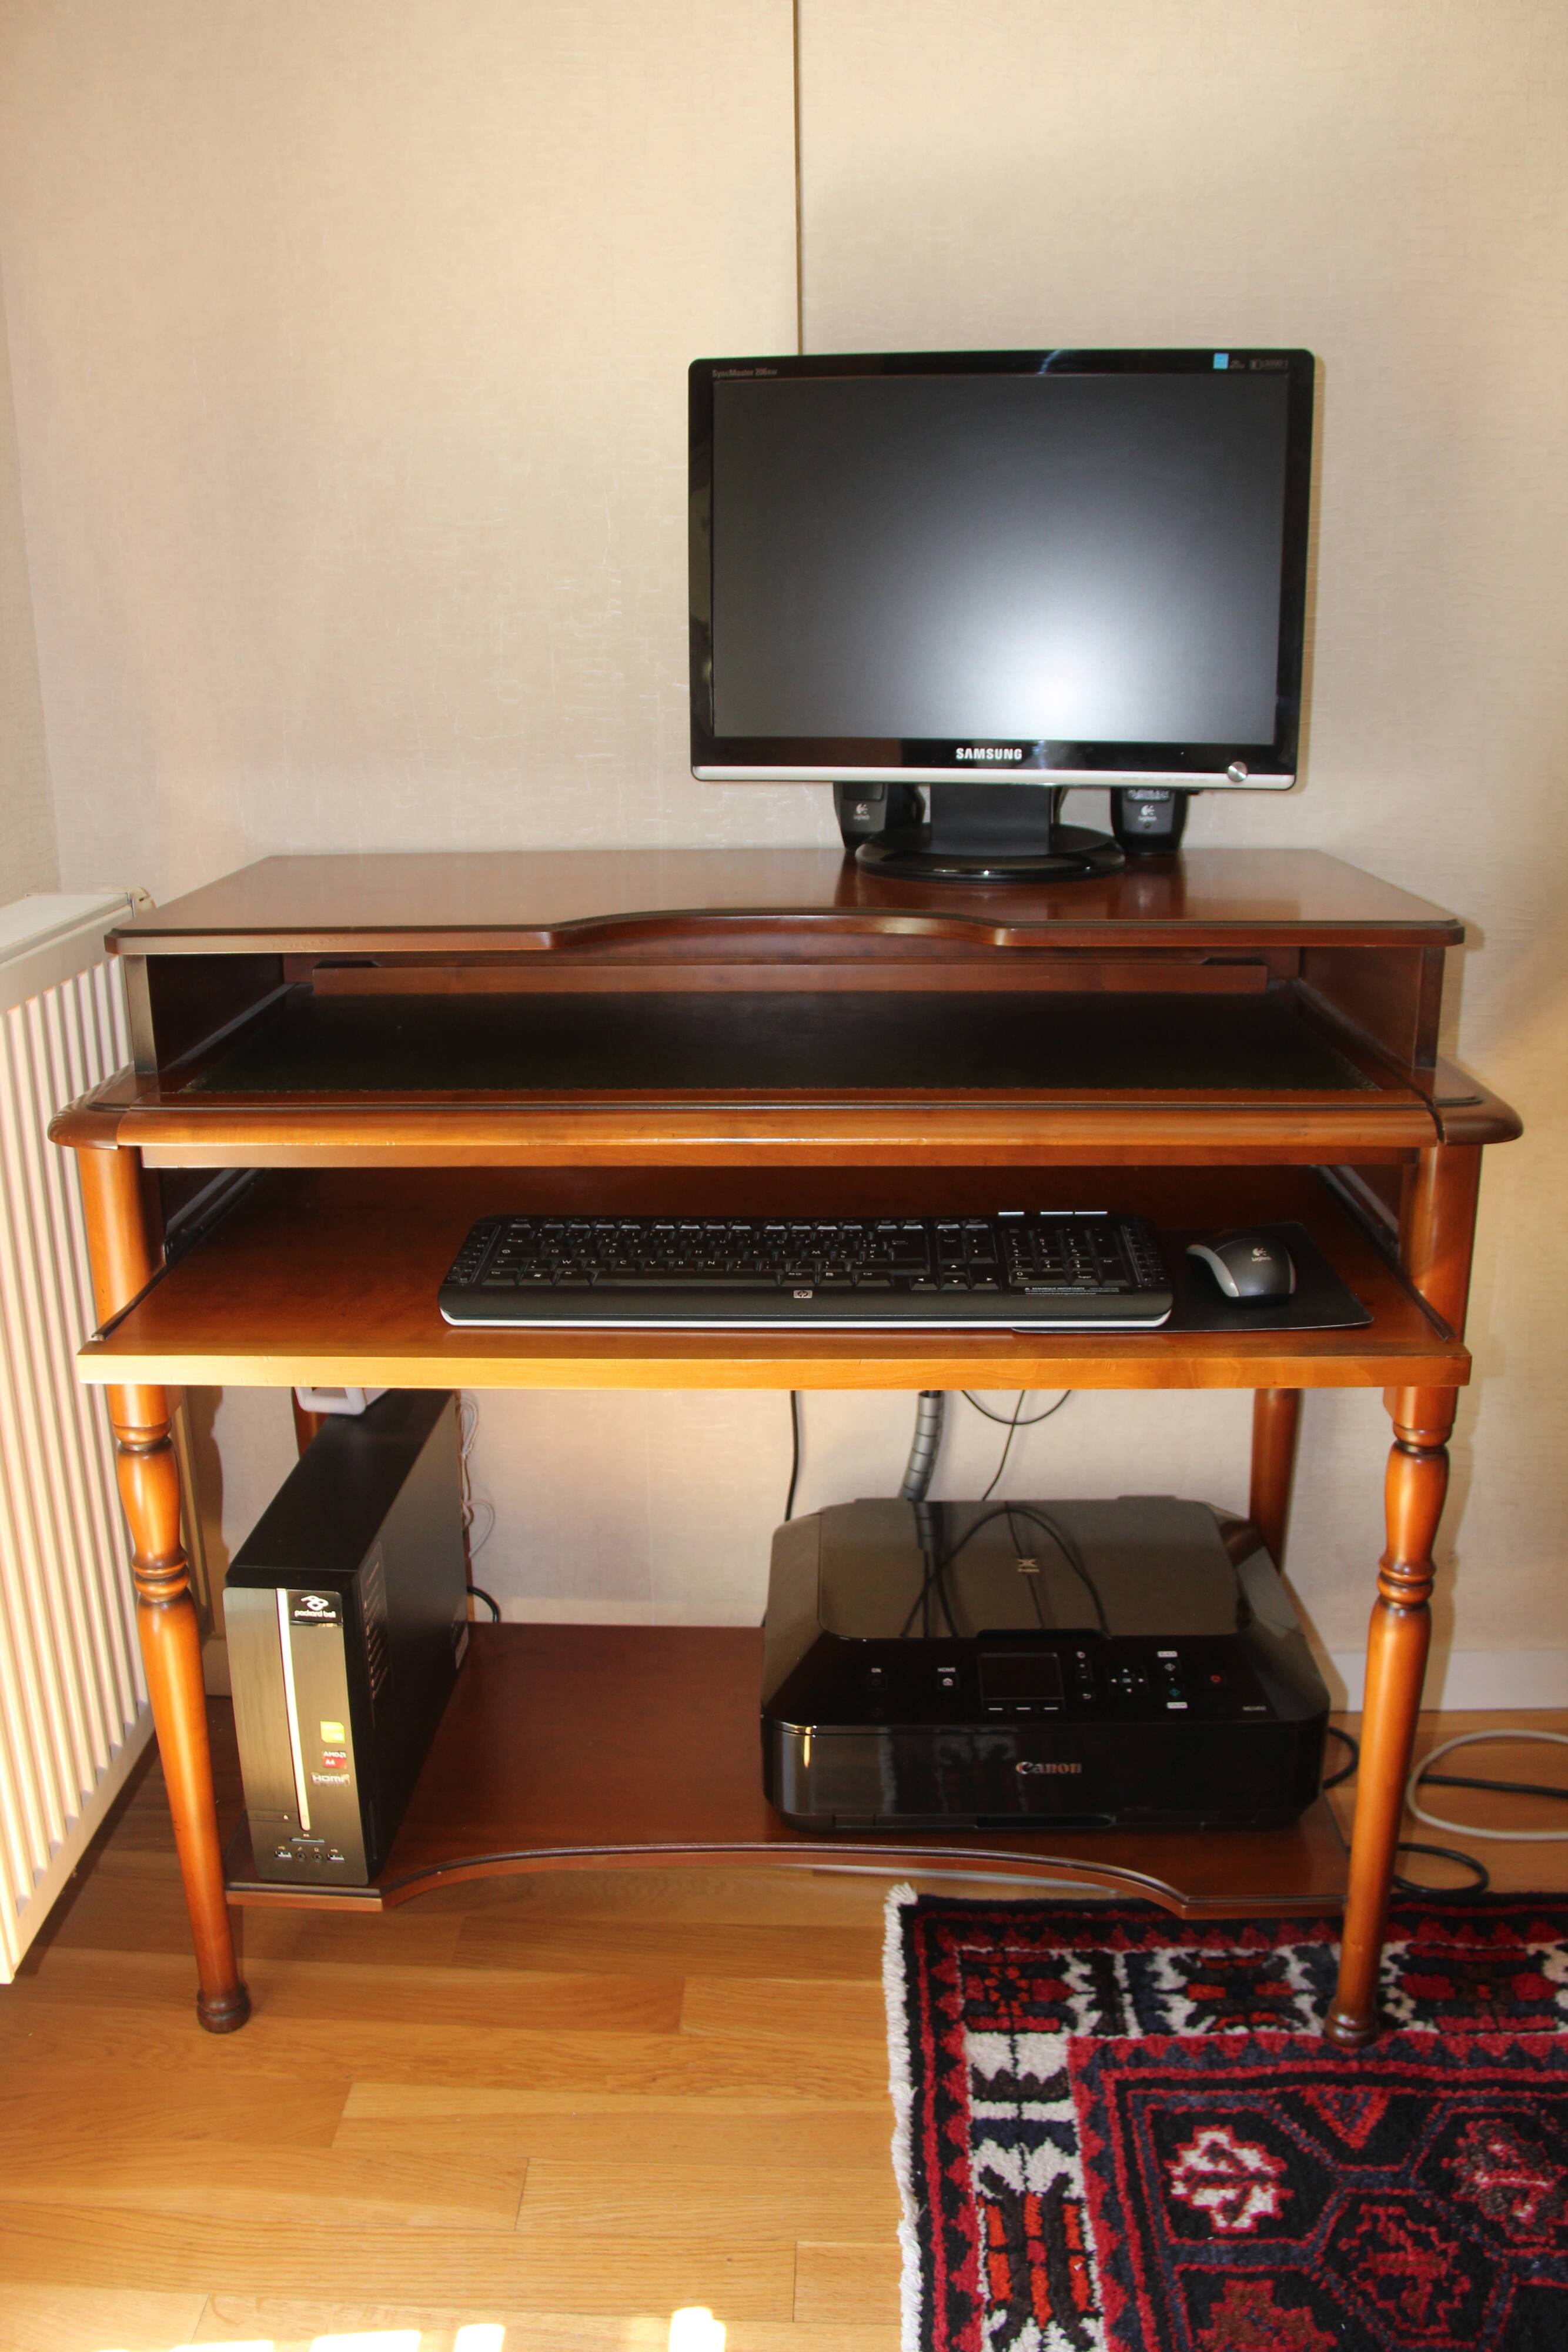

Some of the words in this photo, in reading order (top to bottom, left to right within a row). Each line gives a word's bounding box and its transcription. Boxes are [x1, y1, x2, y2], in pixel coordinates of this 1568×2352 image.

[712, 368, 753, 379] SyncMaster
[955, 747, 1023, 760] SAMSUNG
[295, 1609, 323, 1618] packard
[323, 1611, 336, 1619] bell
[1015, 1761, 1082, 1775] Canon
